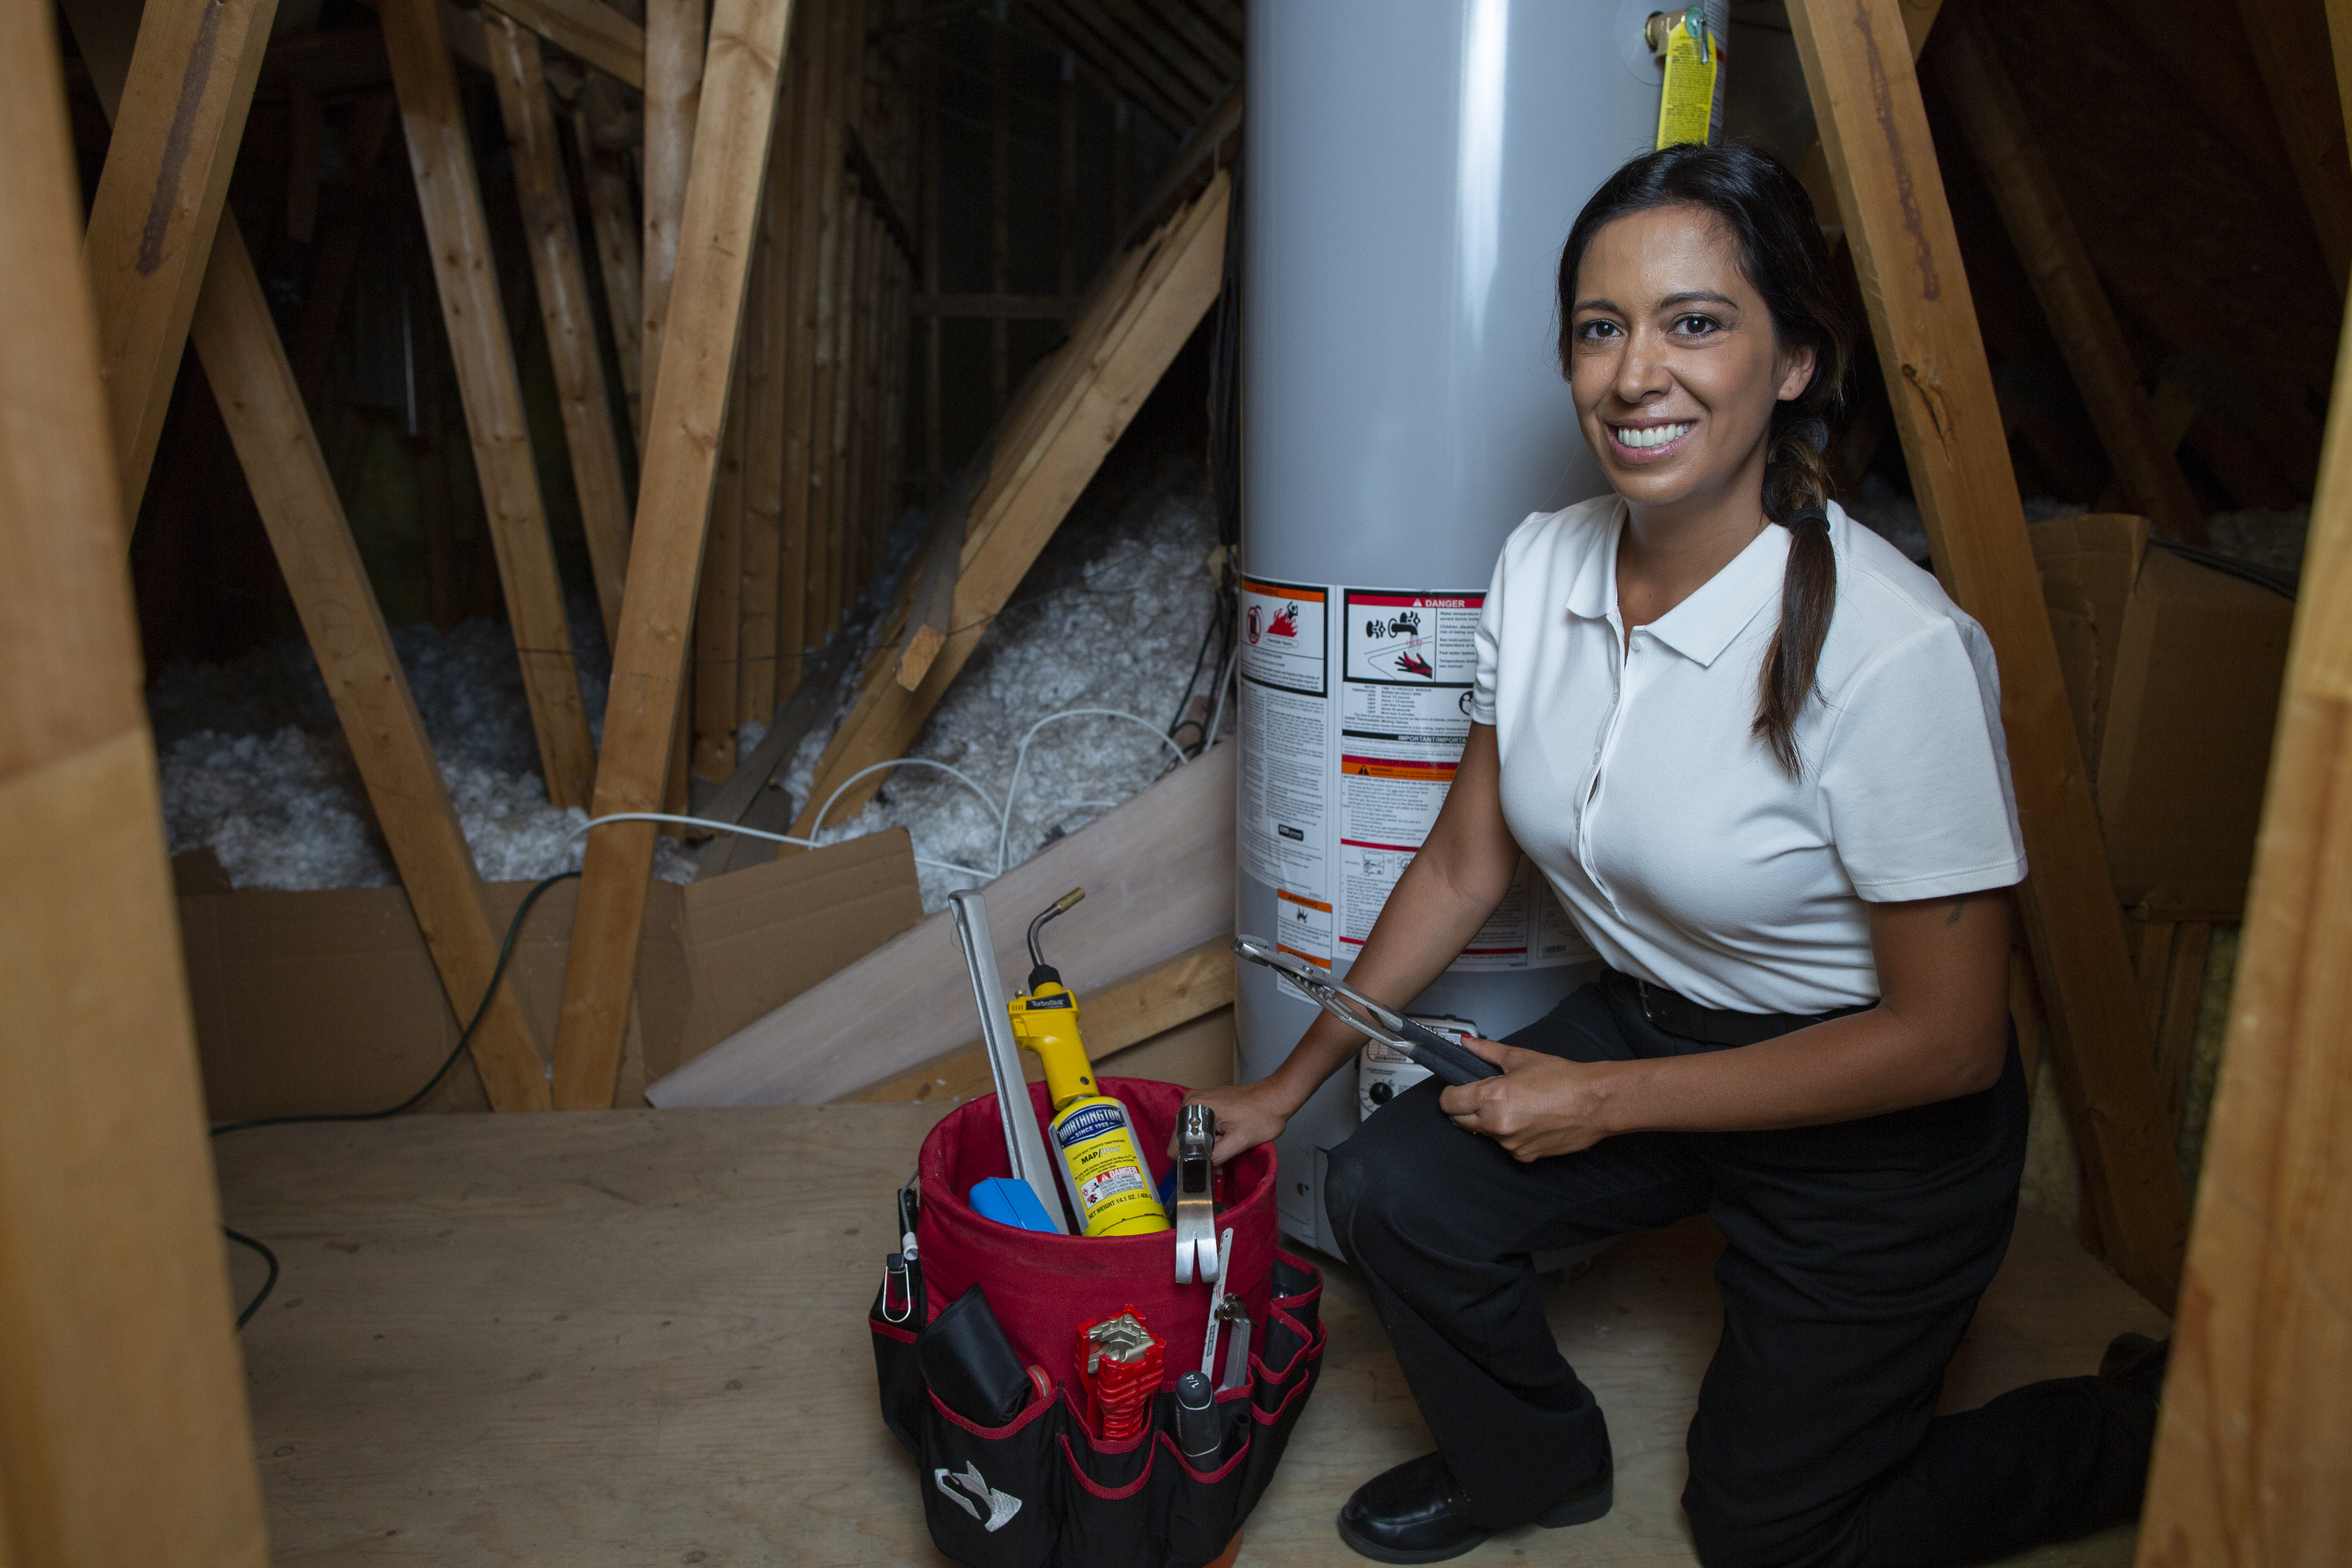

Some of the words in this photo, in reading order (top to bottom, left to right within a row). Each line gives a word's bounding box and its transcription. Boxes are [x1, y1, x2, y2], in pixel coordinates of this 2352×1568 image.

[1059, 1109, 1122, 1142] WORTHINGTON
[1075, 1126, 1094, 1138] SINCE
[1109, 1167, 1138, 1178] DANGER
[1088, 1210, 1096, 1220] NET
[1096, 1200, 1115, 1214] WEIGHT
[1186, 1374, 1199, 1388] 1/4
